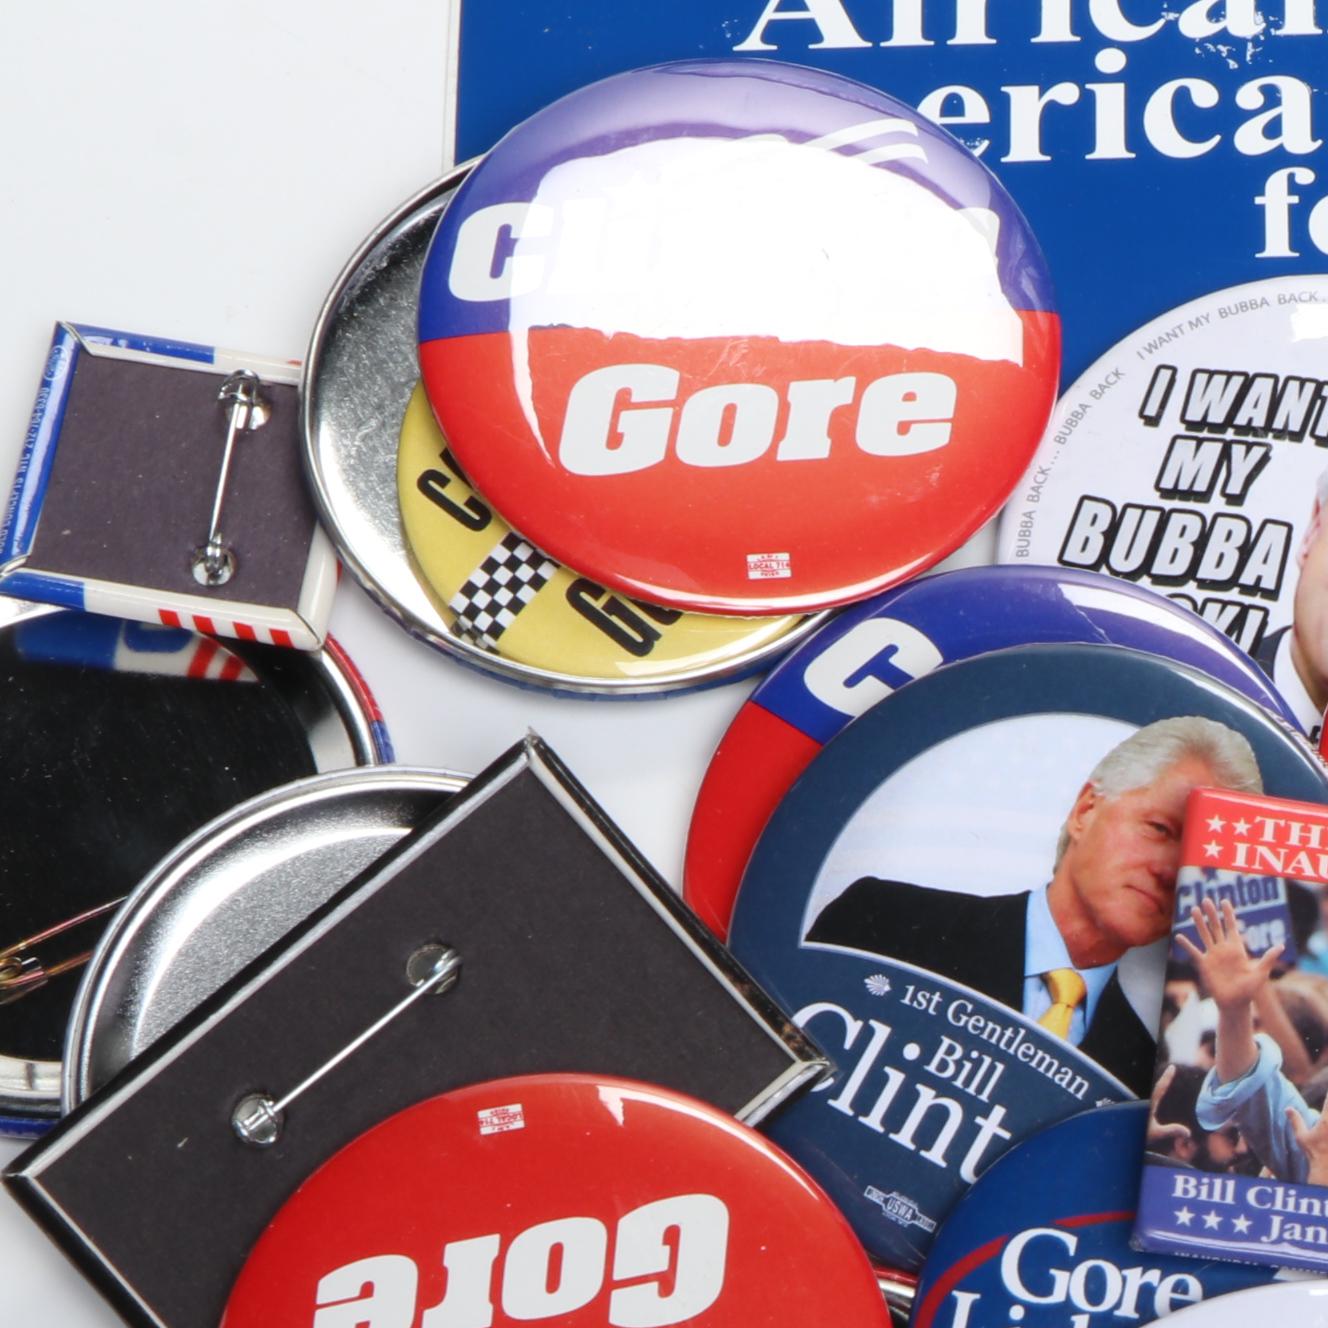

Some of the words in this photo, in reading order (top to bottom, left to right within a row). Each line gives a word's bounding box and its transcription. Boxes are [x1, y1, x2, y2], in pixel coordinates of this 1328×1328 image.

[559, 364, 957, 476] Gore
[1016, 510, 1036, 557] BUBBA
[1054, 402, 1091, 446] BUBBA
[1091, 367, 1126, 400] BACK
[1144, 323, 1186, 354] WANT
[1188, 312, 1212, 332] MY
[1218, 296, 1270, 320] BUBBA
[1138, 365, 1178, 427] I
[1155, 435, 1272, 506] MY
[1058, 495, 1294, 602] BUBBA
[901, 982, 943, 1017] 1st
[947, 999, 1090, 1100] Gentleman
[924, 1036, 1004, 1103] Bill
[1171, 1174, 1235, 1206] Bill
[1000, 1227, 1203, 1320] Gore
